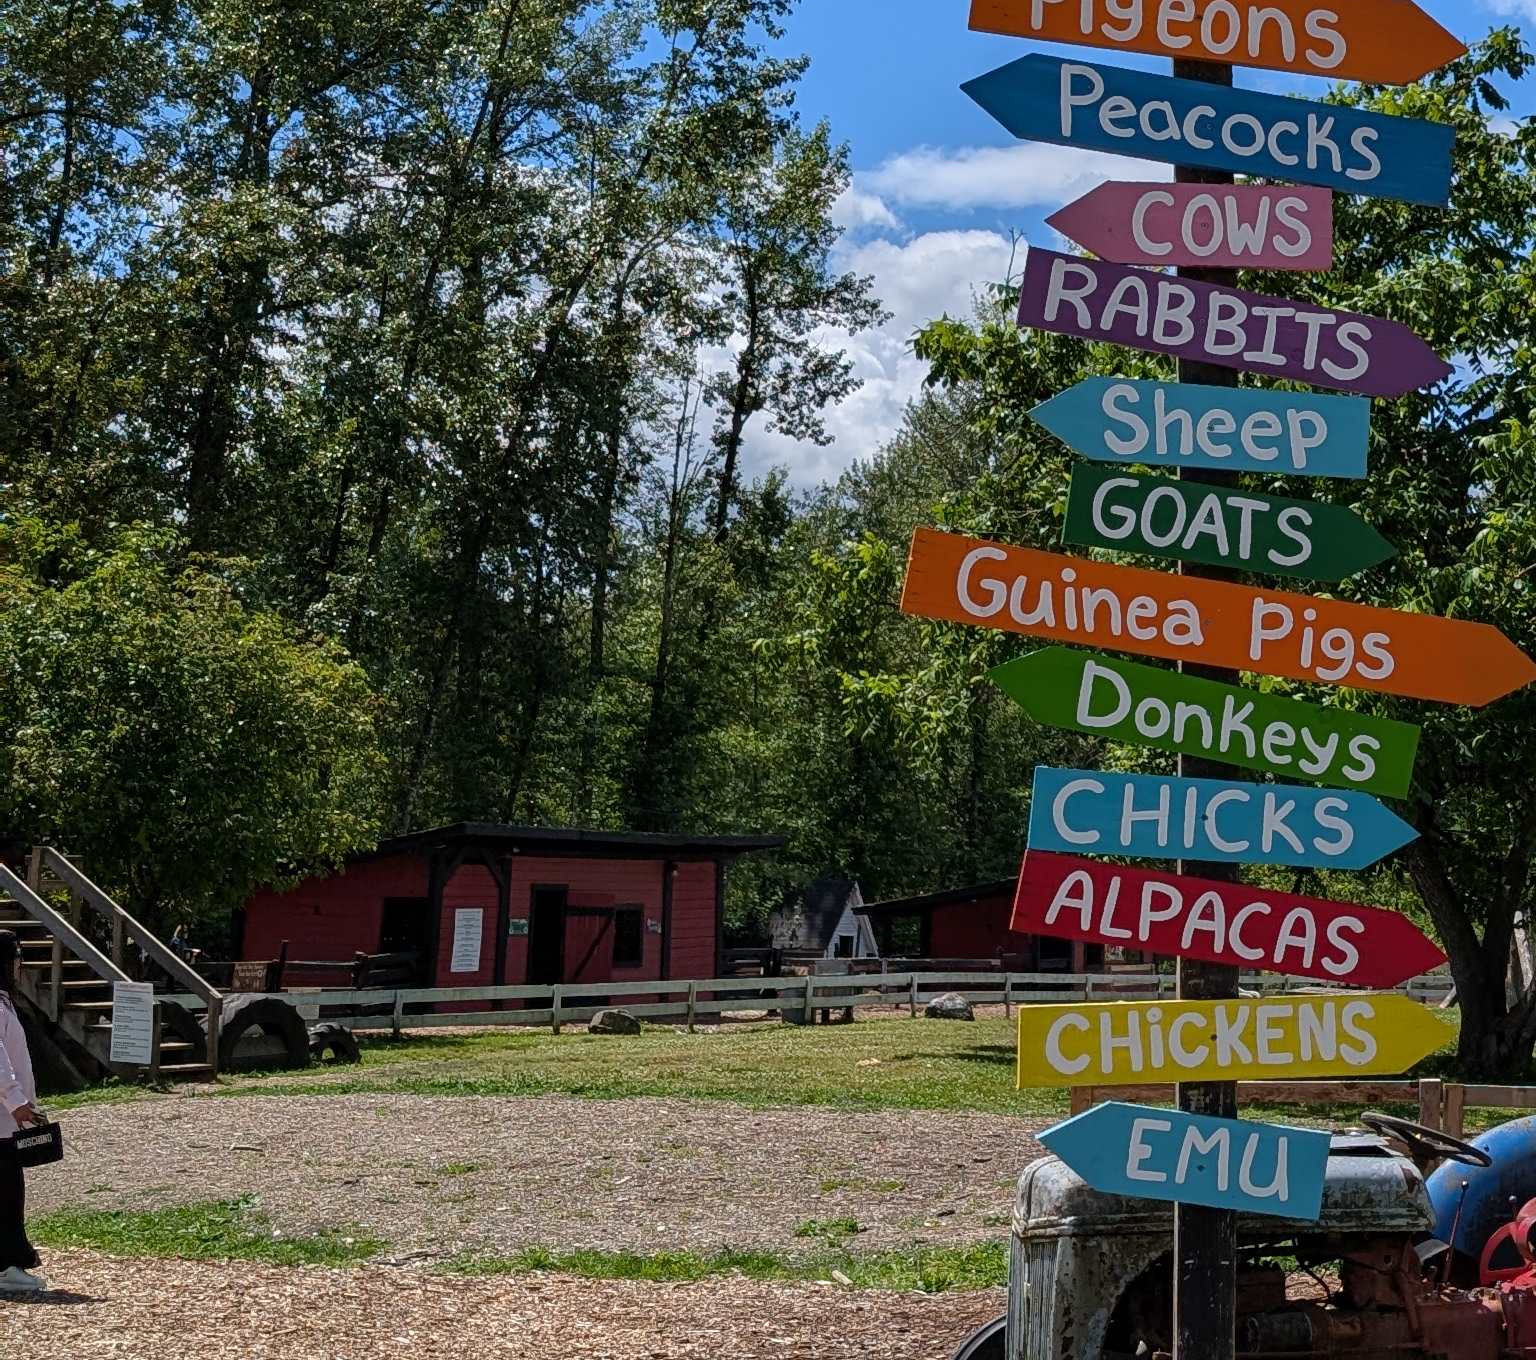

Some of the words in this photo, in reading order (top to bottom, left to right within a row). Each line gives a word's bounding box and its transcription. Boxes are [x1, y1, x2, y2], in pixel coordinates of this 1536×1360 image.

[1132, 191, 1312, 257] COWS
[1043, 256, 1372, 381] RABBITS
[1101, 383, 1329, 469] Sheep
[1092, 477, 1313, 567] GOATS
[956, 546, 1204, 646] Guinea
[1250, 597, 1395, 682] Pigs
[1052, 779, 1355, 854] CHICKS
[1044, 870, 1369, 975] ALPACAS
[1126, 1118, 1288, 1201] EMU
